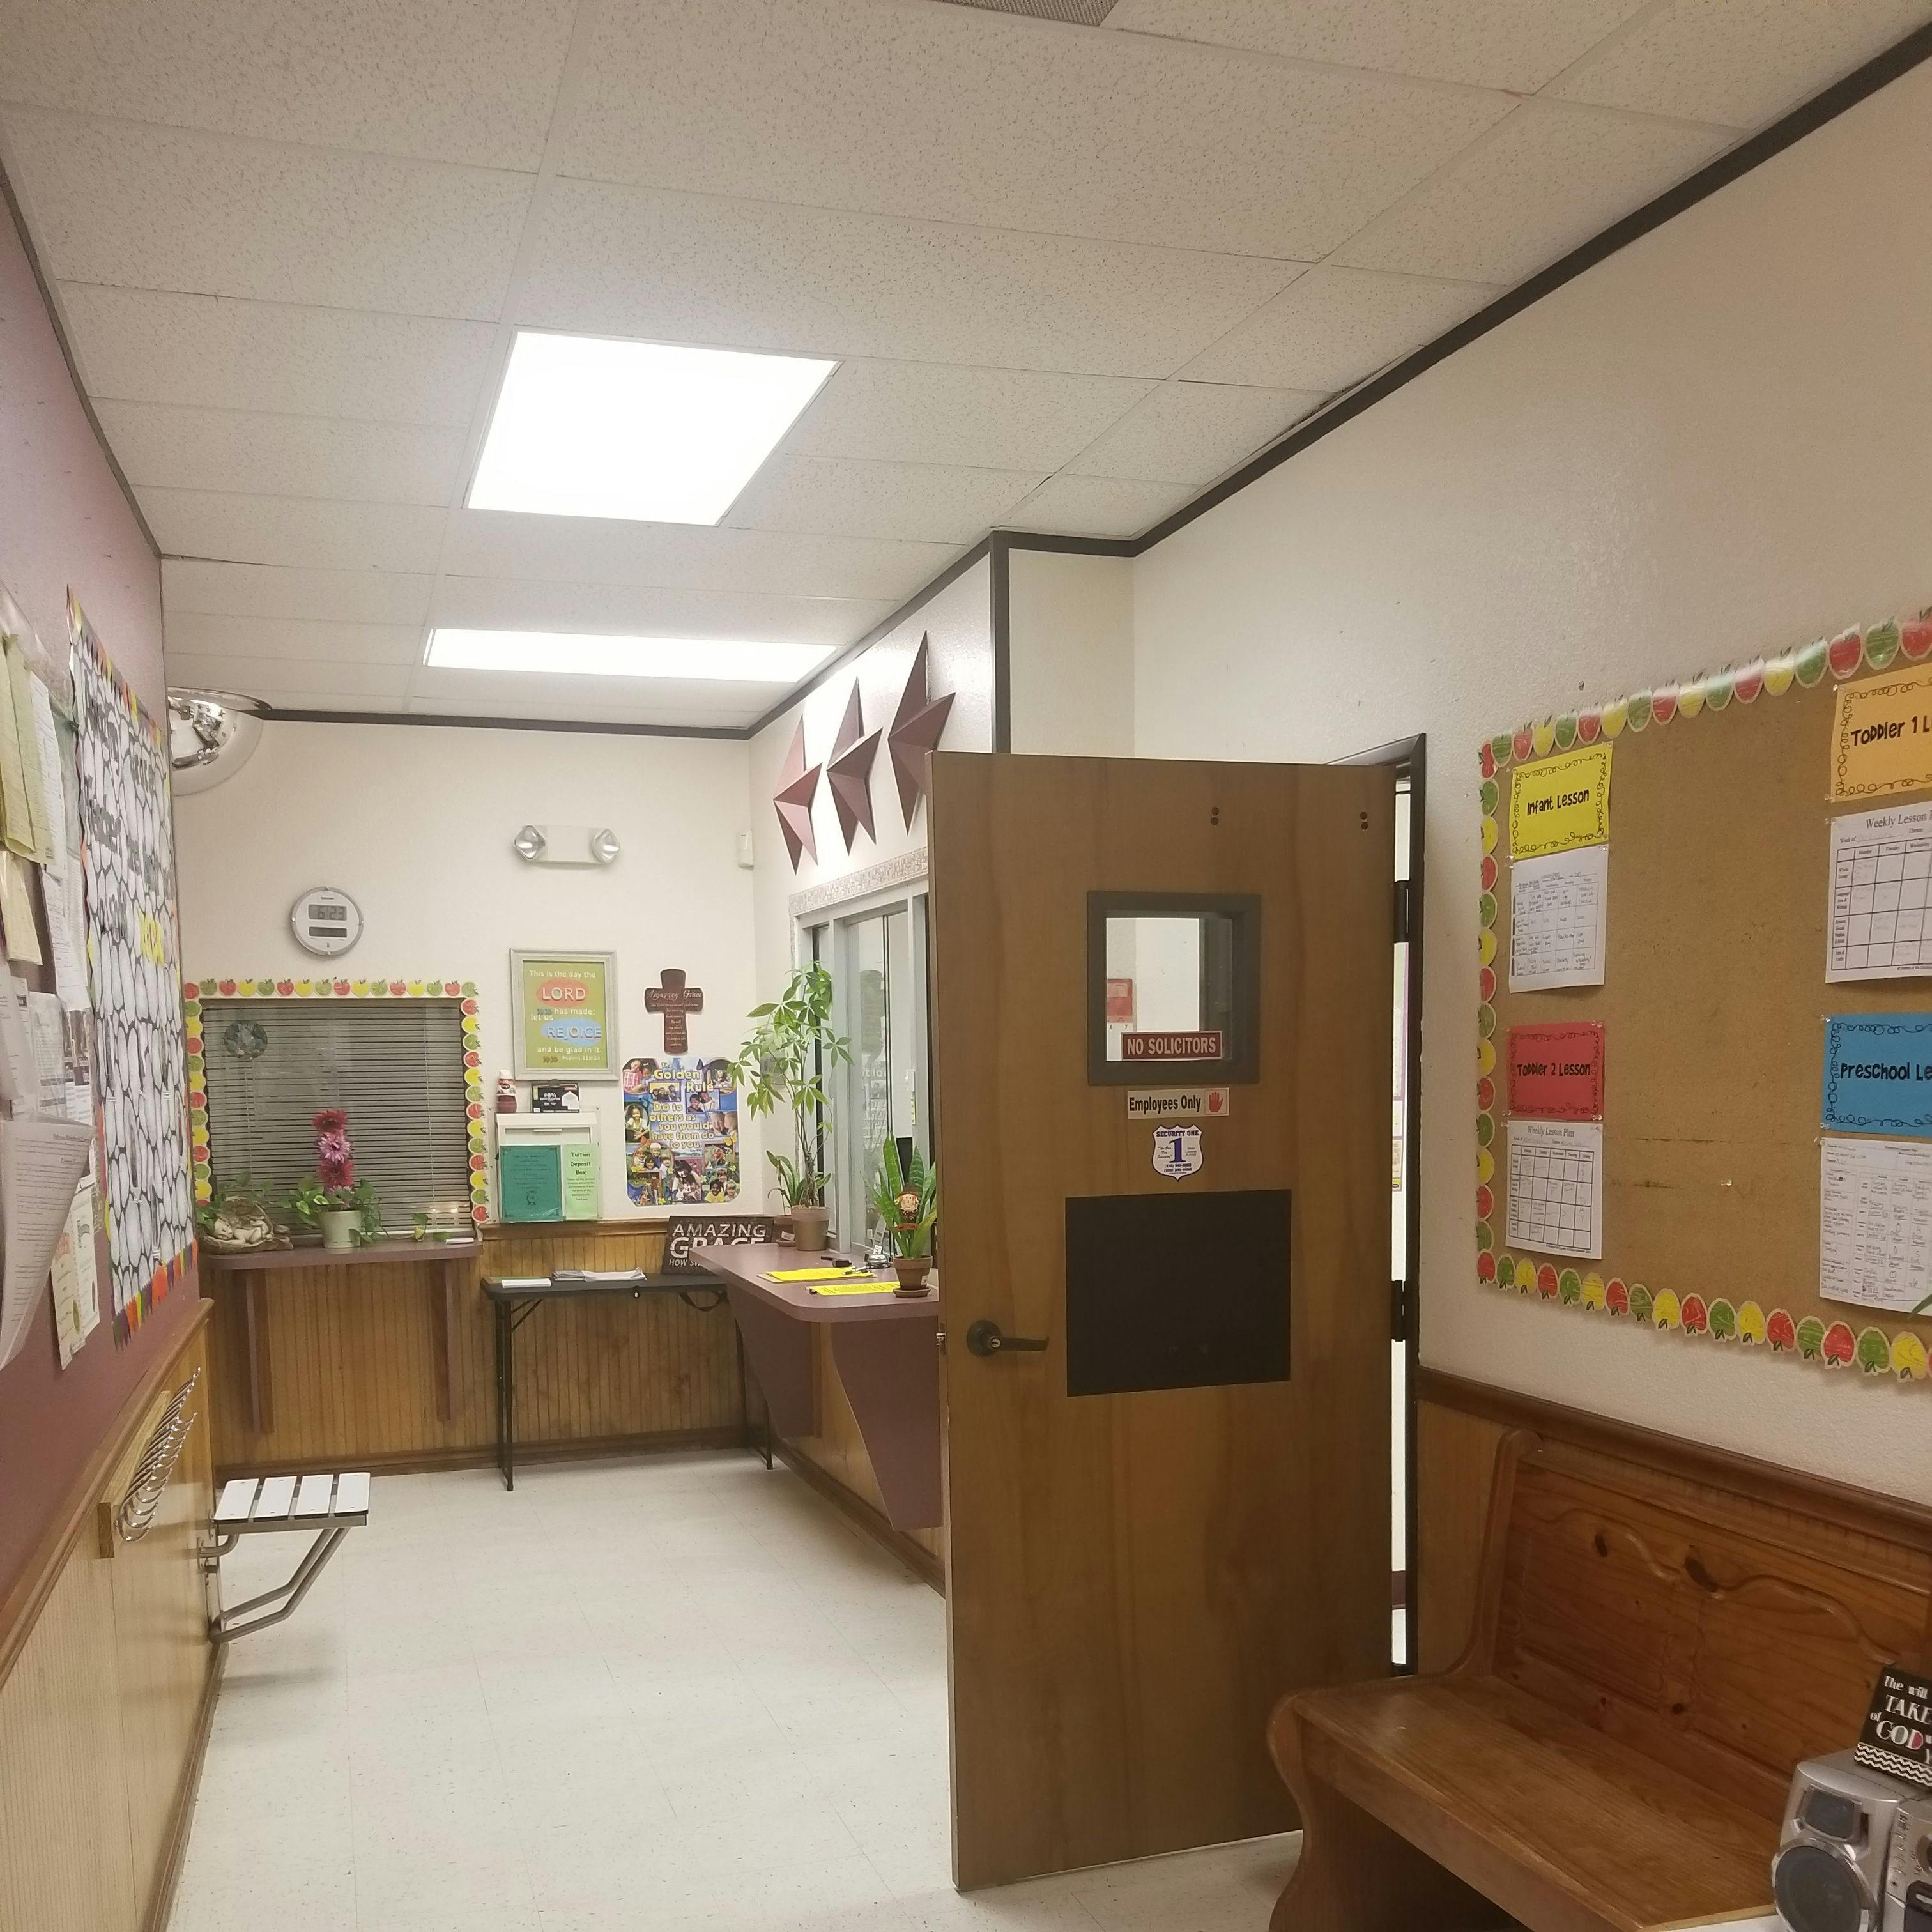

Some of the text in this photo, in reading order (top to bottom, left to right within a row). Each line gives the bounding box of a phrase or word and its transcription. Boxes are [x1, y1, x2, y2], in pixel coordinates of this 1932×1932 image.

[1911, 716, 1917, 734] 1
[1557, 789, 1590, 809] Lesson
[1866, 816, 1896, 829] Weekly
[1898, 814, 1927, 824] Lesson
[542, 987, 586, 1001] LORD
[683, 990, 702, 1000] Grace
[548, 1026, 602, 1040] REJOICE
[566, 1046, 582, 1055] glad
[1127, 1038, 1216, 1055] NO SOLICITORS
[654, 1068, 700, 1080] Golden
[1551, 1062, 1556, 1075] 2
[1559, 1062, 1590, 1077] Lesson
[686, 1081, 714, 1092] Rule
[653, 1101, 683, 1112] Do to
[1129, 1094, 1201, 1114] Employees Only
[649, 1113, 684, 1121] others
[659, 1122, 710, 1131] you would
[1528, 1125, 1575, 1137] Weekly Lesson Plan
[702, 1131, 714, 1139] do
[1169, 1137, 1186, 1163] 1
[672, 1223, 766, 1237] AMAZING
[1884, 1675, 1928, 1699] The will
[1885, 1694, 1932, 1725] TAKE
[1870, 1712, 1882, 1722] of
[1876, 1721, 1924, 1751] GOD
